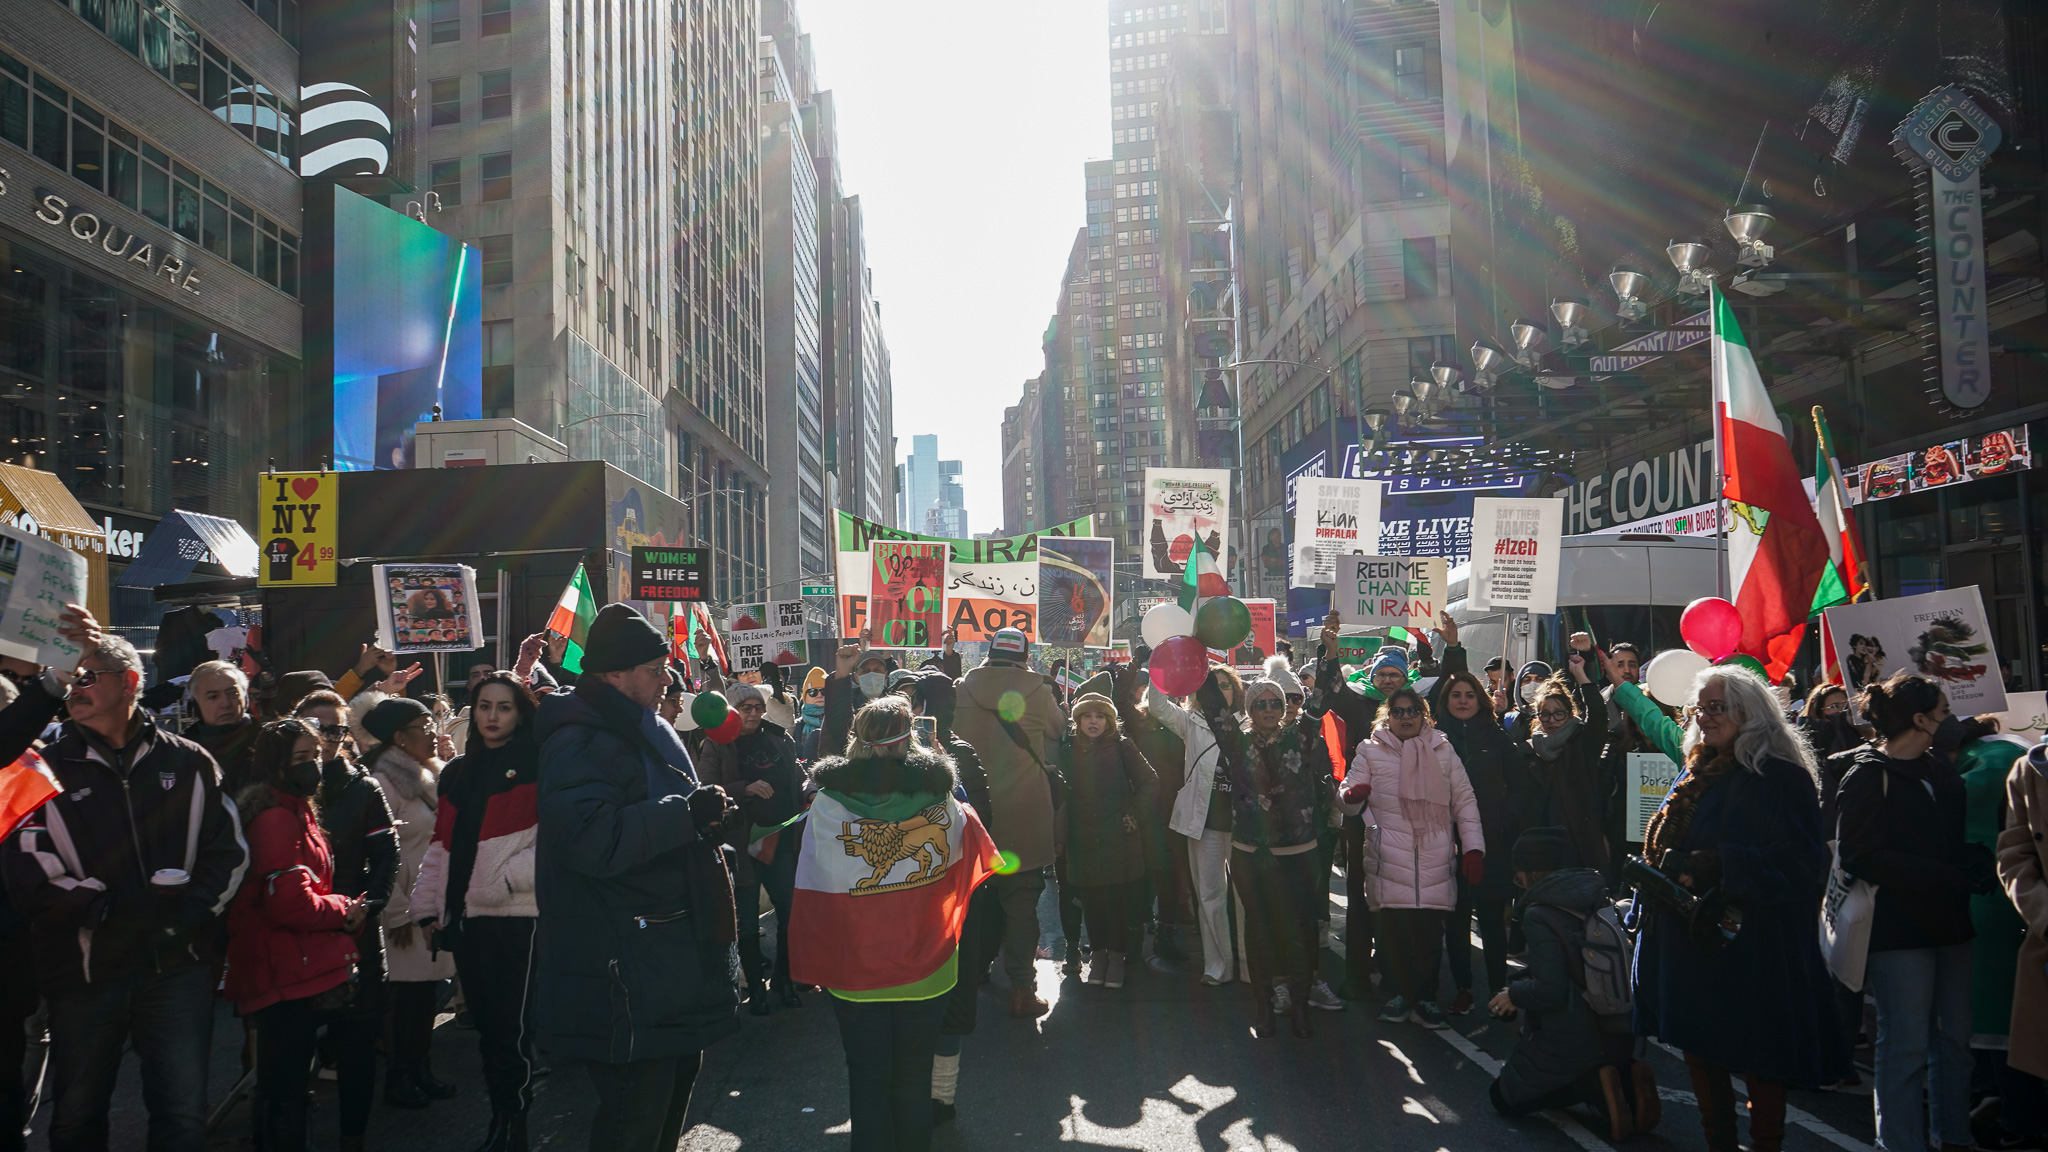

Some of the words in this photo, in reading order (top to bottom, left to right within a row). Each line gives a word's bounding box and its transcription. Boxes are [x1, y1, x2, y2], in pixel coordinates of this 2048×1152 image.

[1913, 94, 1953, 137] CUSTOM
[1959, 99, 1994, 131] BUILT
[1925, 147, 1987, 177] BURGERS
[1942, 190, 1975, 204] THE
[36, 194, 200, 296] SQUARE
[1948, 206, 1980, 394] COUNTER
[276, 478, 288, 502] I
[1318, 485, 1339, 497] SAY
[1342, 486, 1361, 499] HIS
[1553, 475, 1602, 535] THE
[272, 504, 321, 534] NY
[1317, 506, 1358, 529] Kian
[1496, 509, 1514, 520] SAY
[1516, 509, 1541, 521] THEIR
[1416, 516, 1474, 535] LIVE
[1495, 520, 1539, 536] NAMES
[1315, 528, 1357, 540] PIRFALAK
[874, 543, 899, 559] BE
[901, 543, 944, 560] OUR
[1494, 538, 1538, 556] #Izeh
[272, 554, 288, 563] NY
[644, 551, 697, 565] WOMEN
[656, 568, 685, 581] LIFE
[1356, 560, 1429, 580] REGIME
[640, 585, 700, 599] FREEDOM
[1357, 579, 1431, 597] CHANGE
[779, 603, 803, 614] FREE
[1357, 599, 1374, 615] IN
[1381, 598, 1432, 617] IRAN
[1913, 613, 1936, 622] FREE
[1938, 607, 1964, 618] IRAN
[780, 614, 803, 627] IRAN
[731, 633, 741, 643] No
[743, 632, 749, 641] To
[751, 631, 775, 640] Islamic
[883, 619, 928, 647] CE
[740, 644, 763, 657] FREE
[1338, 647, 1366, 658] STOP
[741, 656, 764, 669] IRAN
[1951, 683, 1975, 691] WOMAN
[1952, 692, 1984, 701] FREEDOM
[1640, 760, 1676, 779] FREE
